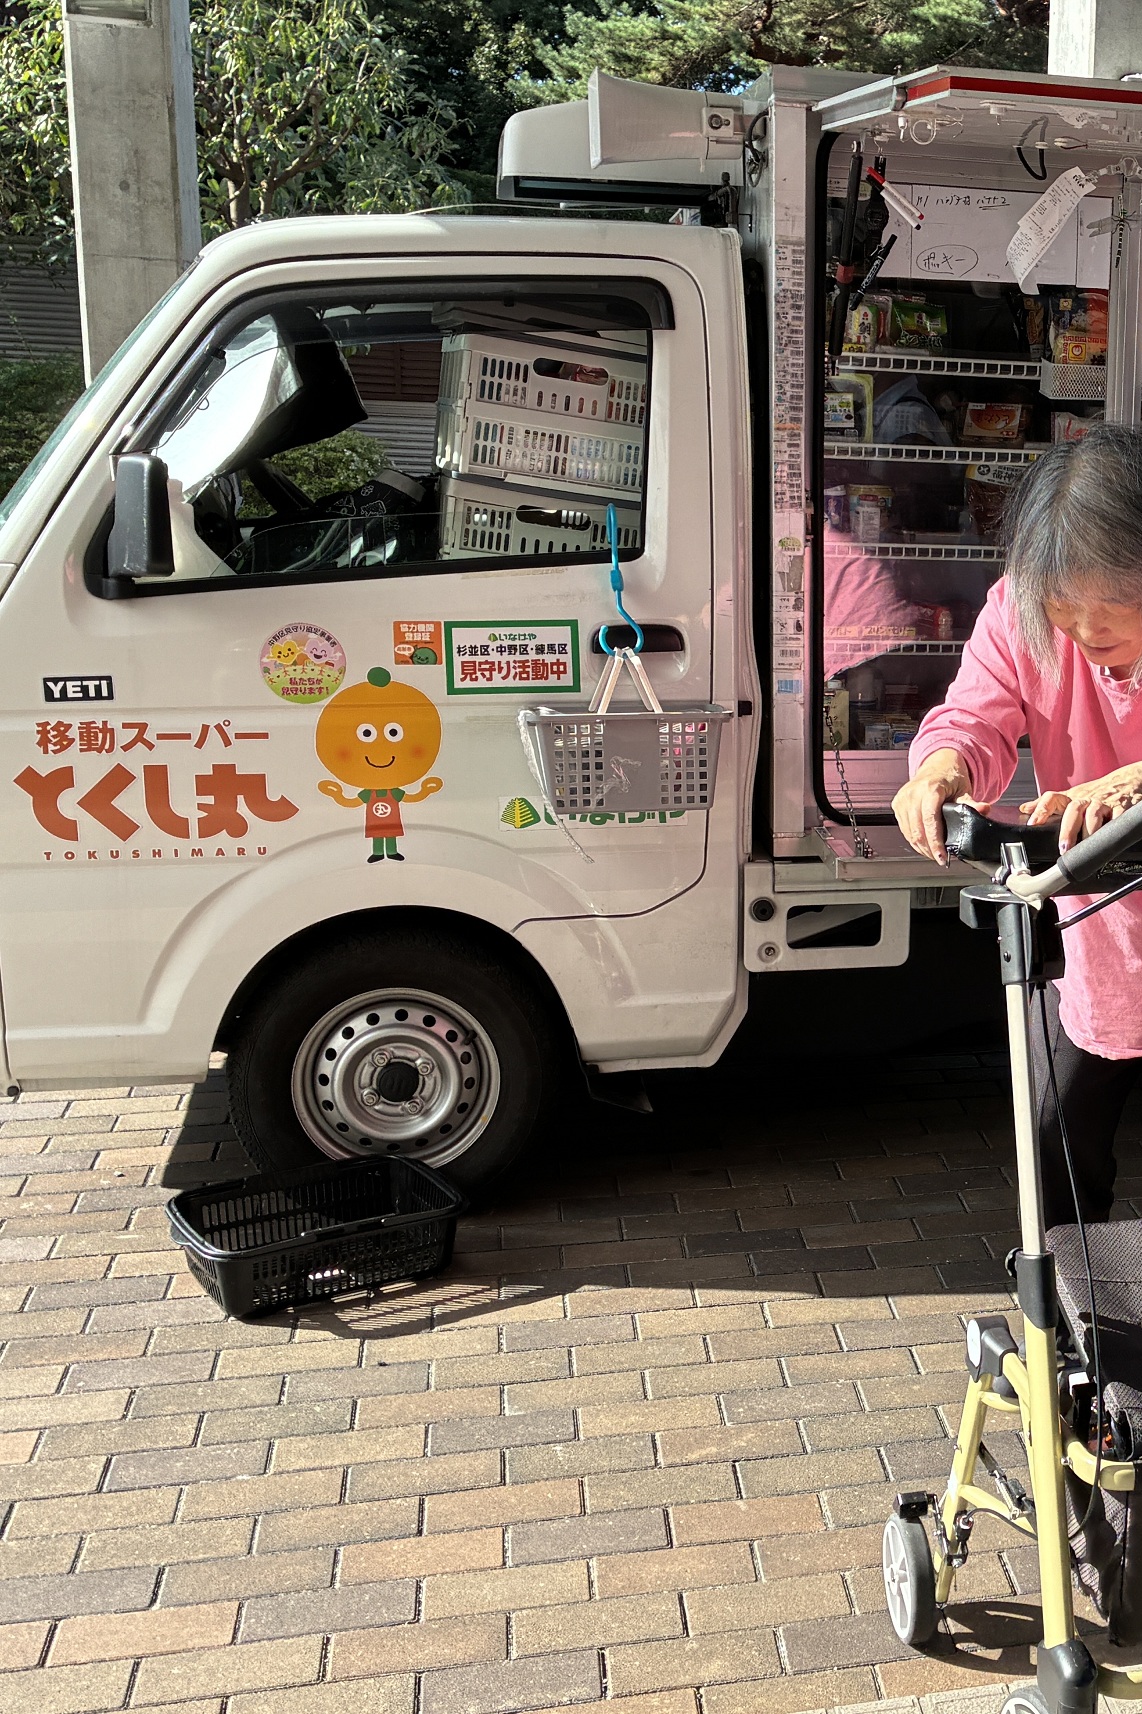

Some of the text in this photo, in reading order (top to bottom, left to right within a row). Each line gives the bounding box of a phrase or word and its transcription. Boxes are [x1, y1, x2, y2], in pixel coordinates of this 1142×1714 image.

[460, 659, 567, 682] 見守り活動中
[46, 680, 108, 698] YETI
[289, 677, 323, 686] 私たちが
[35, 720, 269, 755] 移動スーパー
[13, 763, 299, 842] とくし丸
[44, 846, 267, 861] TOKUSHIMARU
